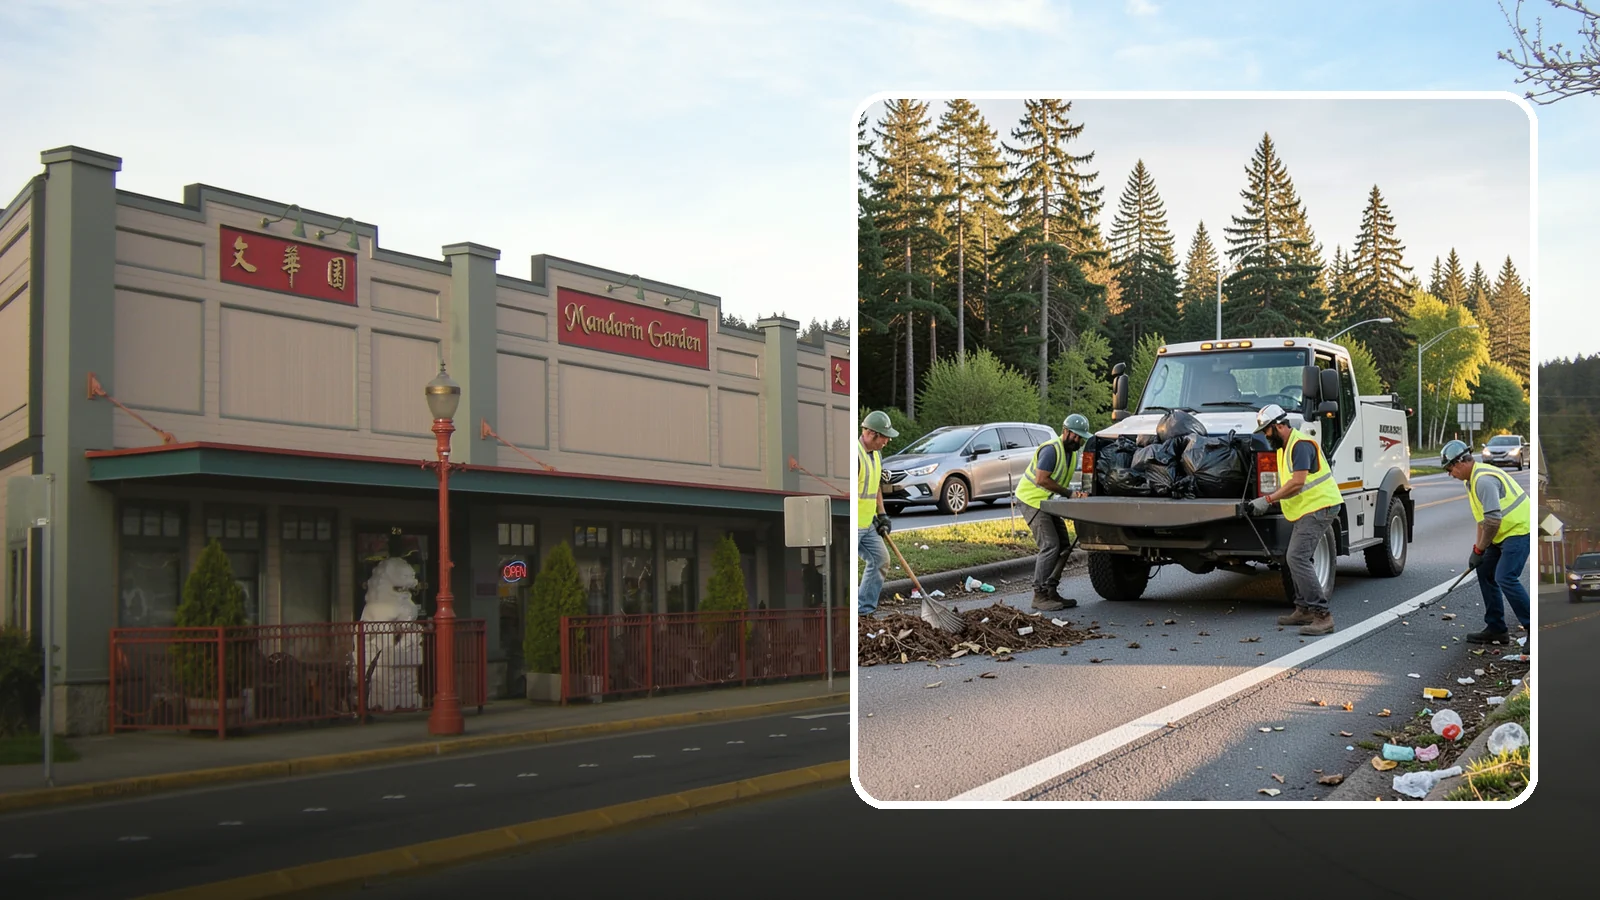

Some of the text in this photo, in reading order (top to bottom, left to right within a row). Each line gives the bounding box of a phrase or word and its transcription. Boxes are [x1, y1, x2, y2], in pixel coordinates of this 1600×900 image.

[564, 302, 702, 352] Mandarin Garden
[503, 565, 527, 578] OPEN
